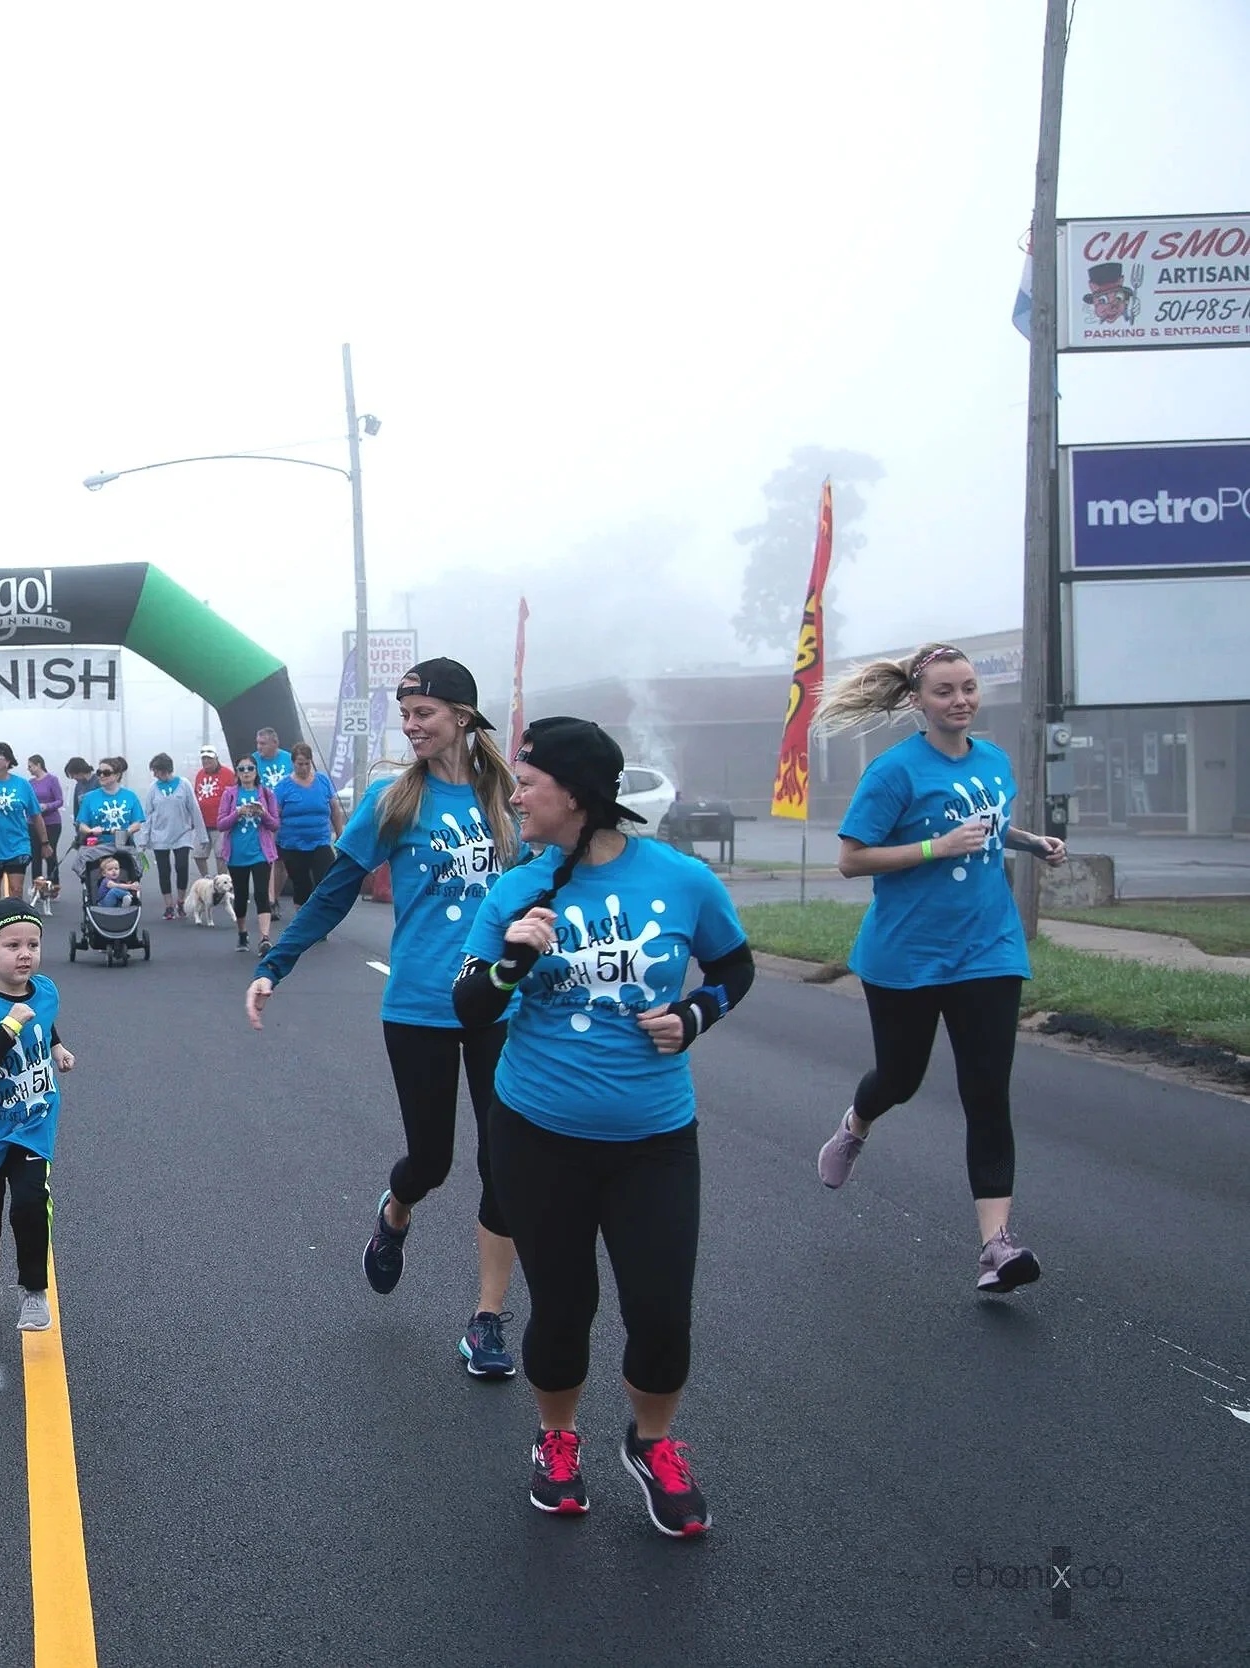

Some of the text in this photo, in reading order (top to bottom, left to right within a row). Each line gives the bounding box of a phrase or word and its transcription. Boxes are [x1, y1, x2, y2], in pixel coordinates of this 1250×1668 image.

[1083, 230, 1149, 262] CM
[1157, 265, 1250, 285] ARTISAN
[1154, 297, 1250, 322] 501-985-1
[1083, 328, 1146, 339] PARKING
[1150, 327, 1160, 337] &
[1164, 324, 1240, 336] ENTRANCE
[367, 637, 412, 649] BACCO
[368, 650, 412, 662] UPER
[343, 717, 368, 731] 25
[943, 786, 998, 822] SPLASH
[430, 817, 493, 852] SPLASH
[432, 856, 468, 881] DASH
[538, 949, 639, 993] DASH 5K
[32, 1066, 54, 1094] 5K
